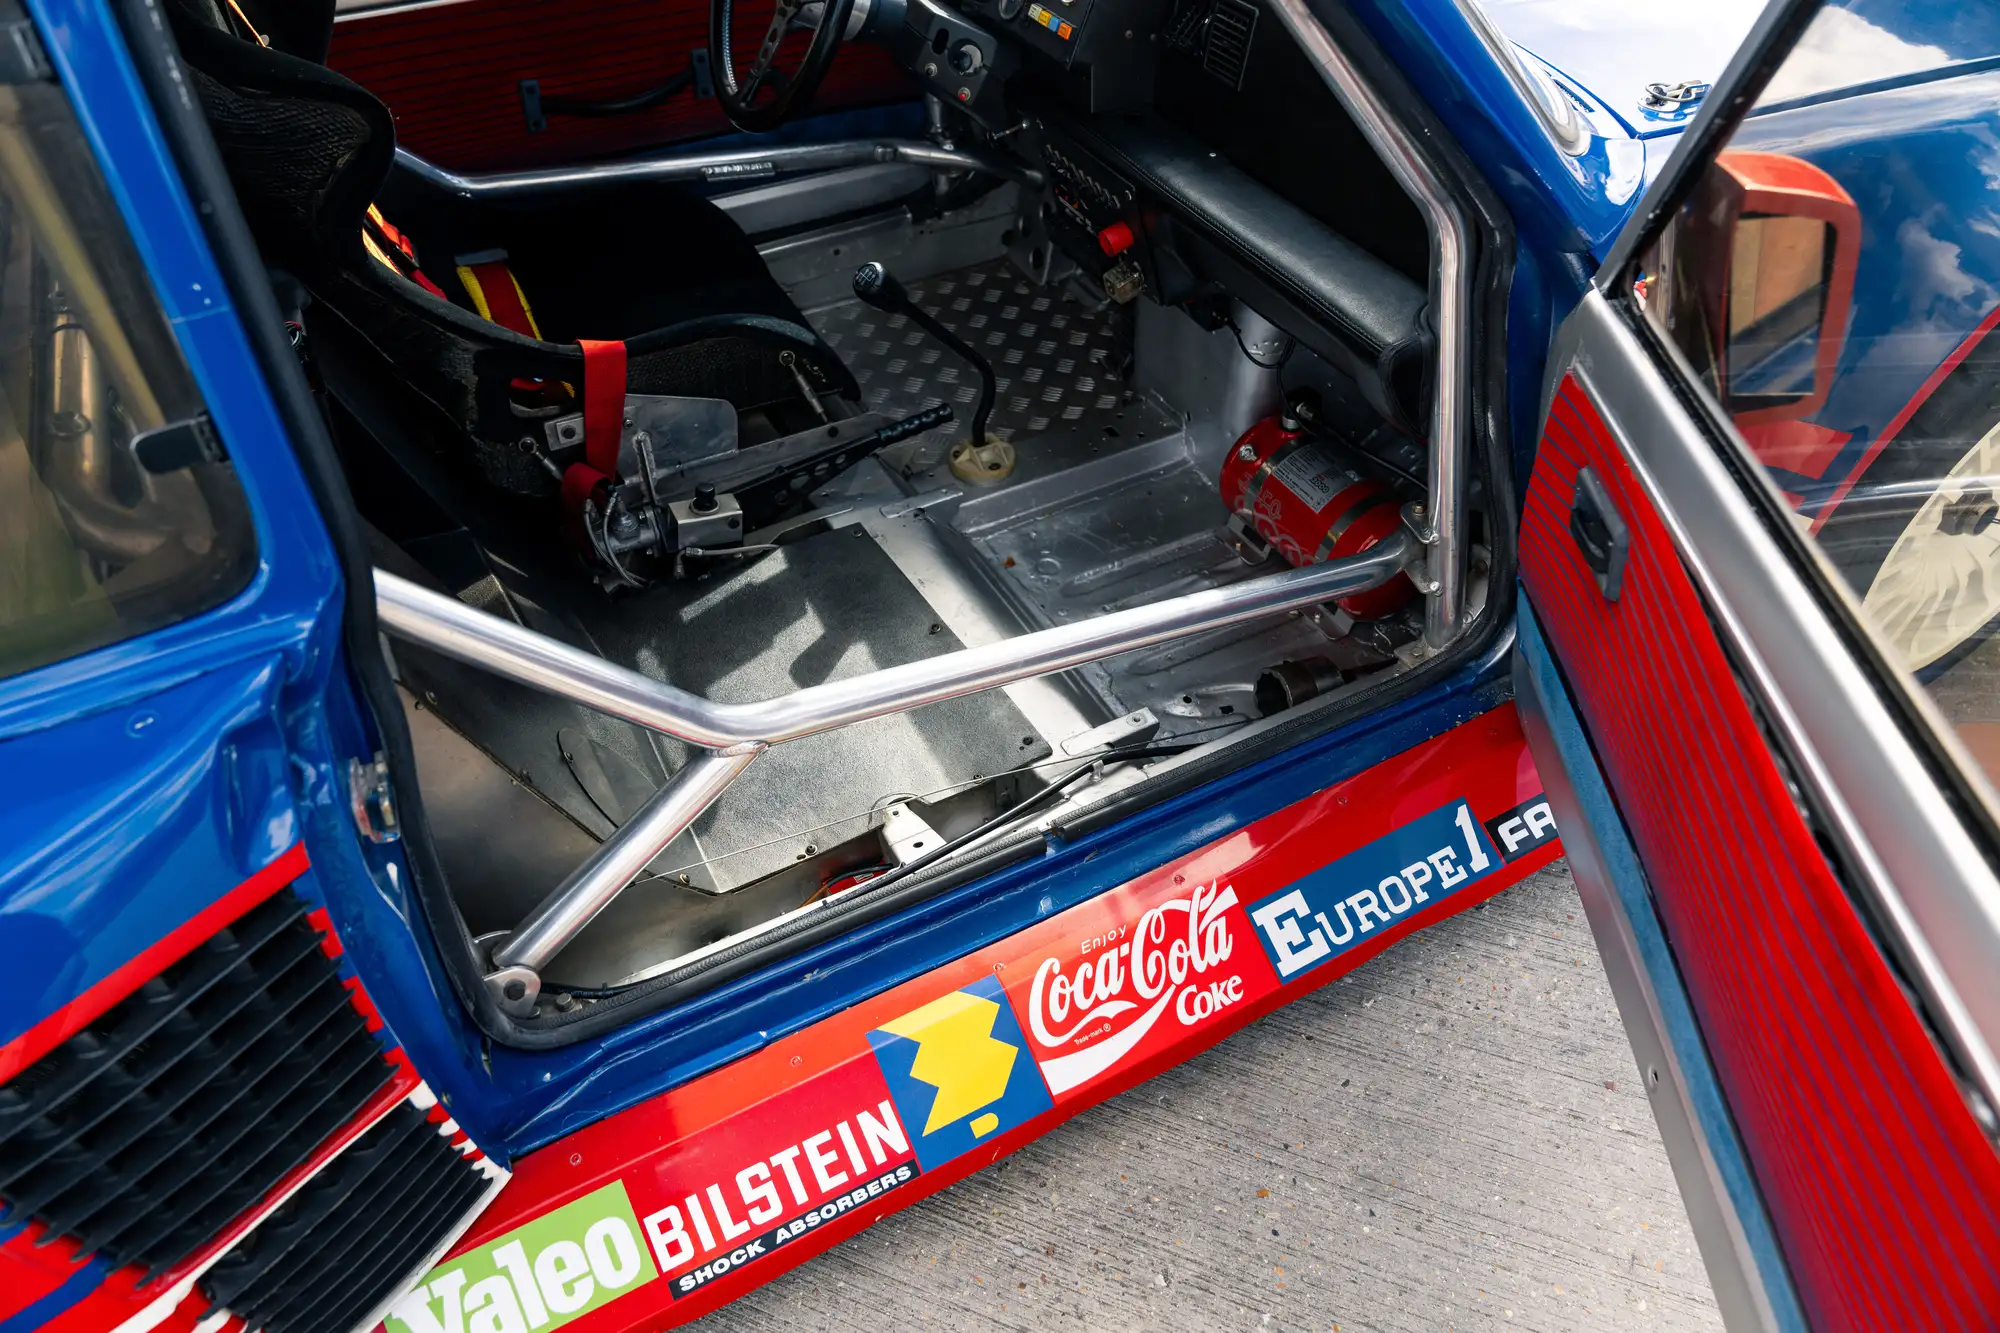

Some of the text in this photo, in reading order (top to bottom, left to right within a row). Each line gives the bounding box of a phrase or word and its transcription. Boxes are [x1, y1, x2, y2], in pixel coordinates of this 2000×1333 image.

[1028, 879, 1238, 1047] Coca-Cola
[1081, 925, 1127, 954] Enjoy
[1176, 975, 1244, 1026] Coke
[643, 1099, 910, 1273] BILSTEIN
[679, 1166, 911, 1292] SHOCK ABSORBERS
